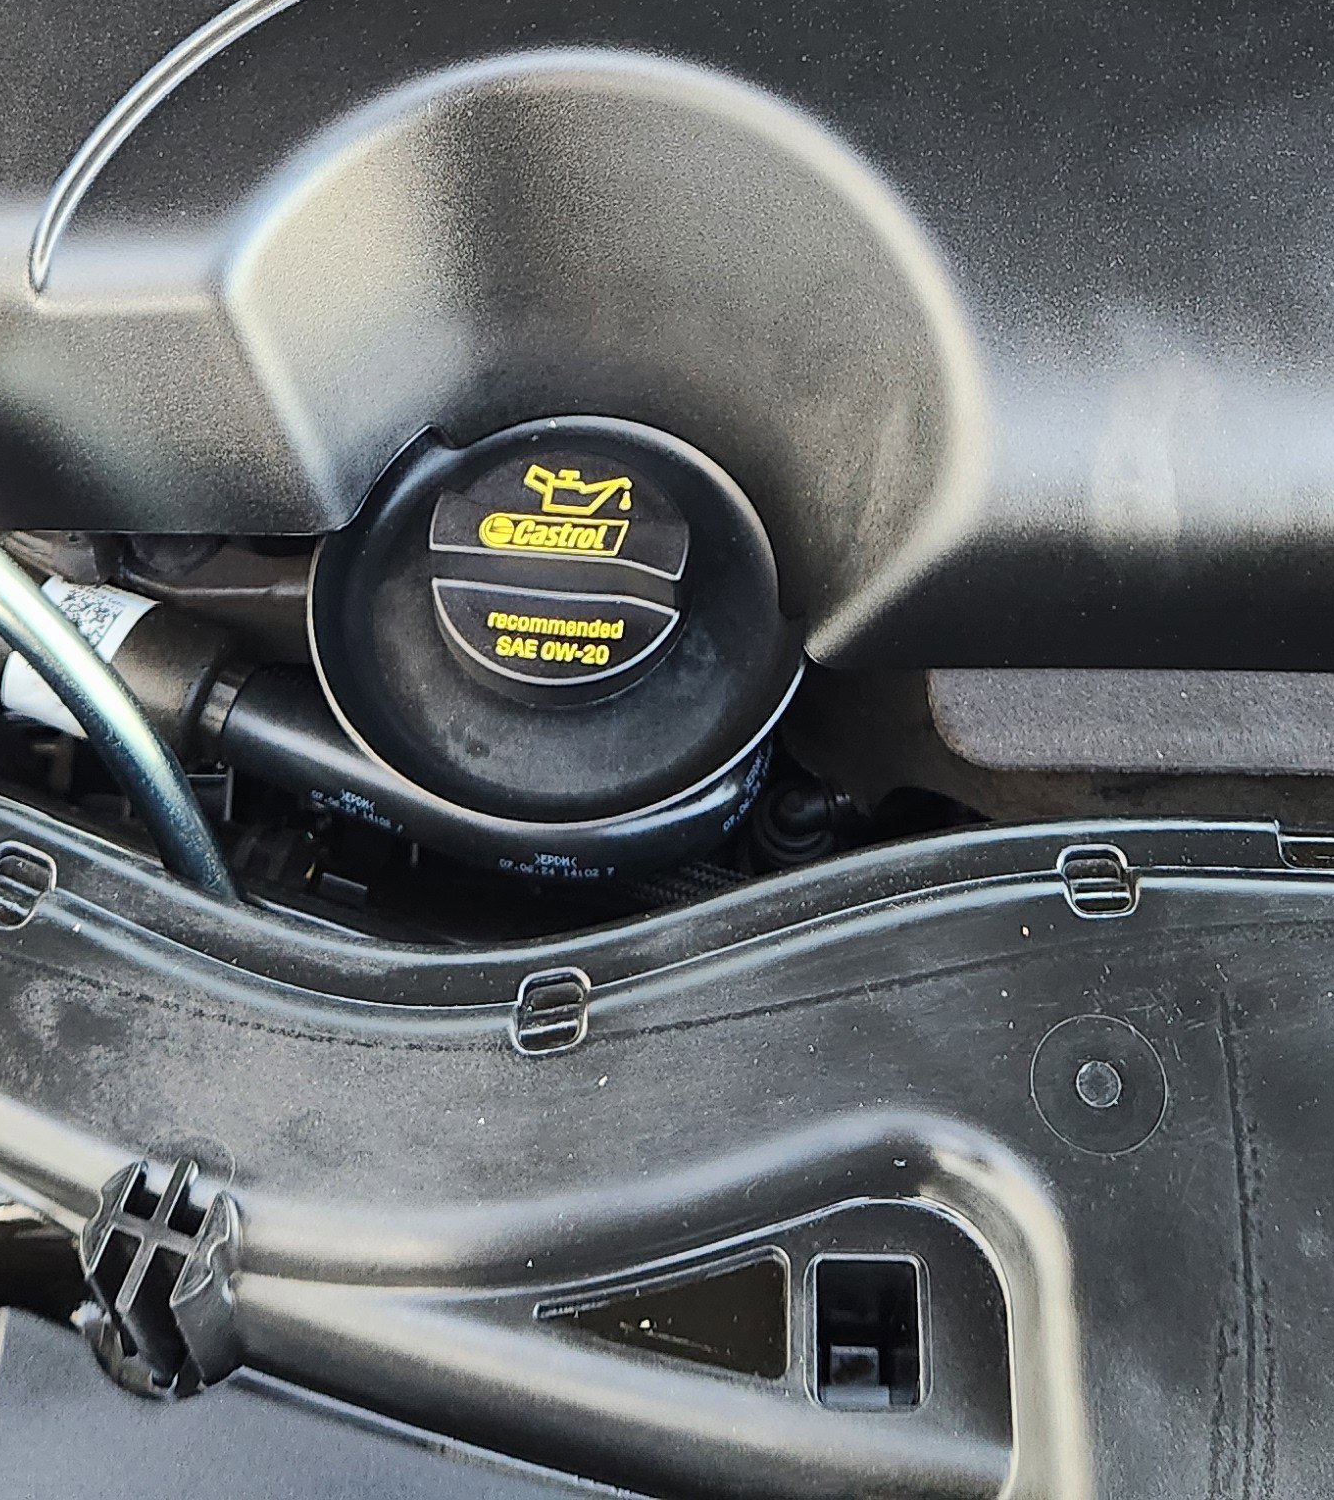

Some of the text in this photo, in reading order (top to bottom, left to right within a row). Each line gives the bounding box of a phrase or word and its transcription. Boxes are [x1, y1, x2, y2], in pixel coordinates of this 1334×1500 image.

[513, 519, 608, 550] Castrol
[487, 612, 624, 639] recommended
[495, 635, 610, 665] SAE 0W-20
